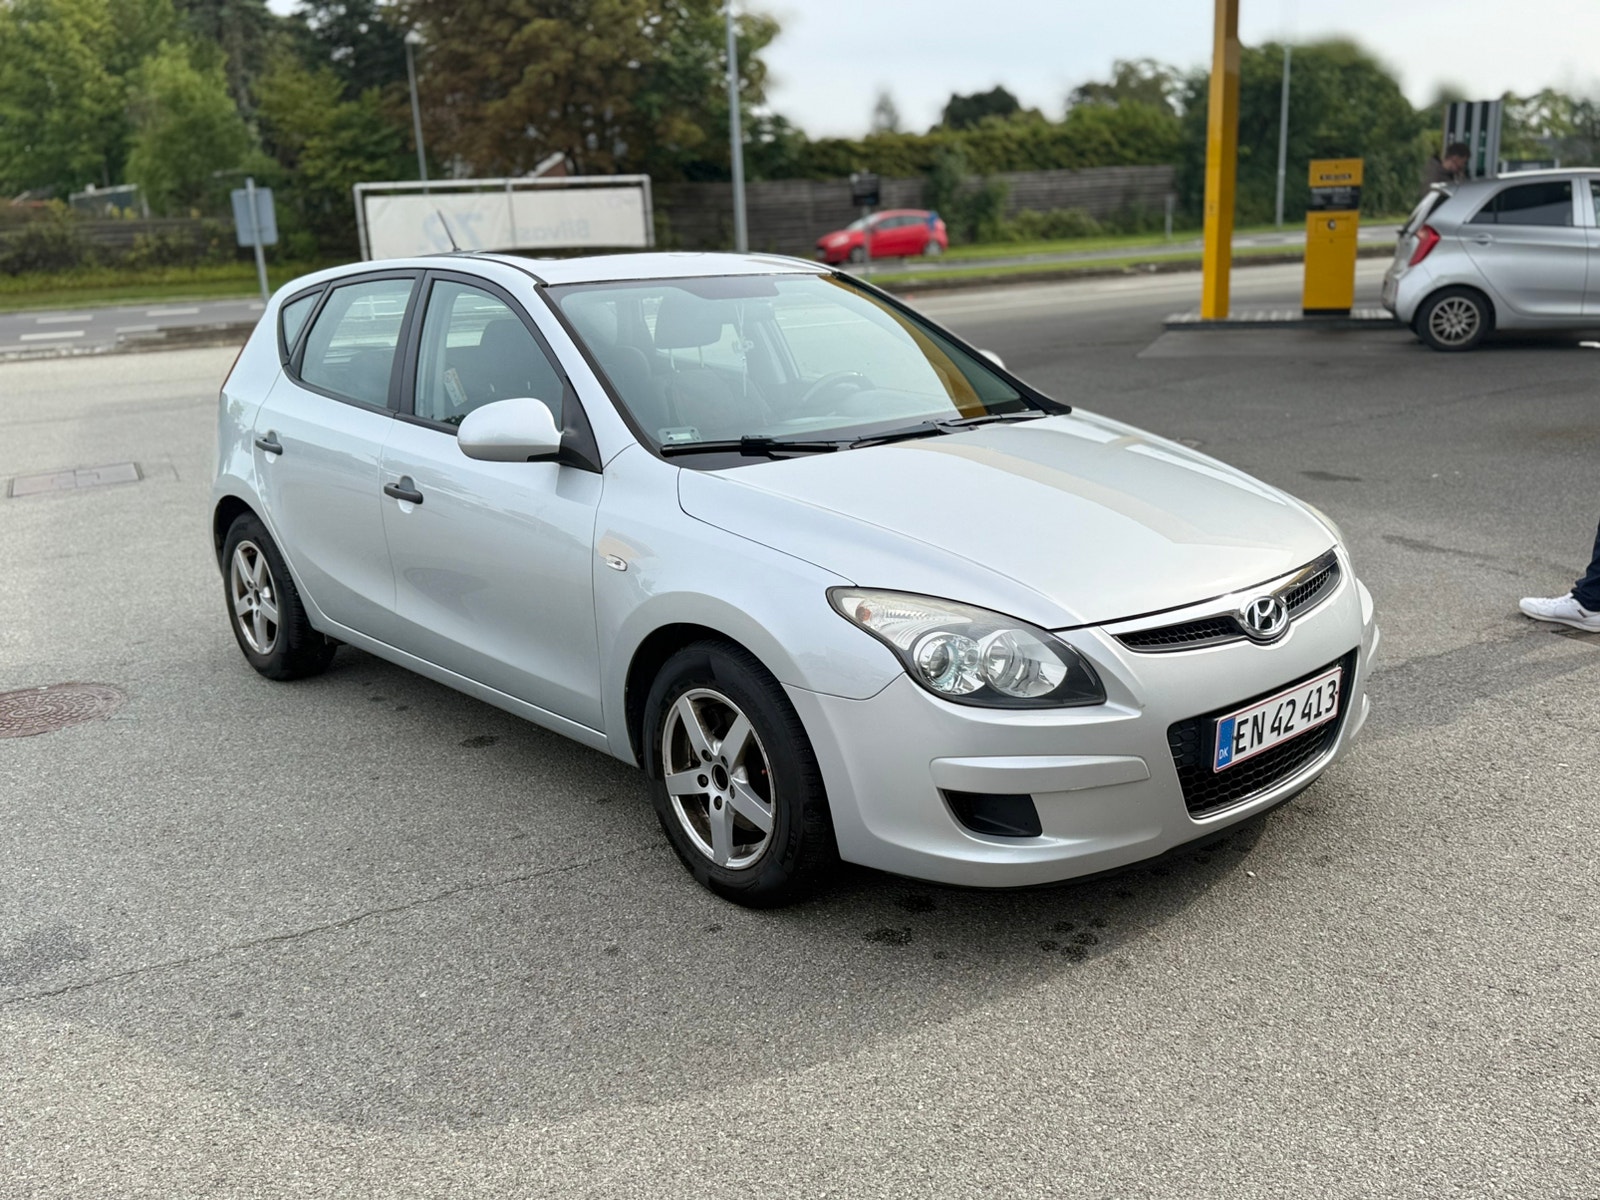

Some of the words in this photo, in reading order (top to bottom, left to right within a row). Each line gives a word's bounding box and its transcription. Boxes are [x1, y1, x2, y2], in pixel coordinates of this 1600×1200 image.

[1234, 711, 1266, 755] EN
[1270, 698, 1296, 737] 42
[1301, 680, 1337, 723] 413
[1218, 748, 1229, 759] DK
